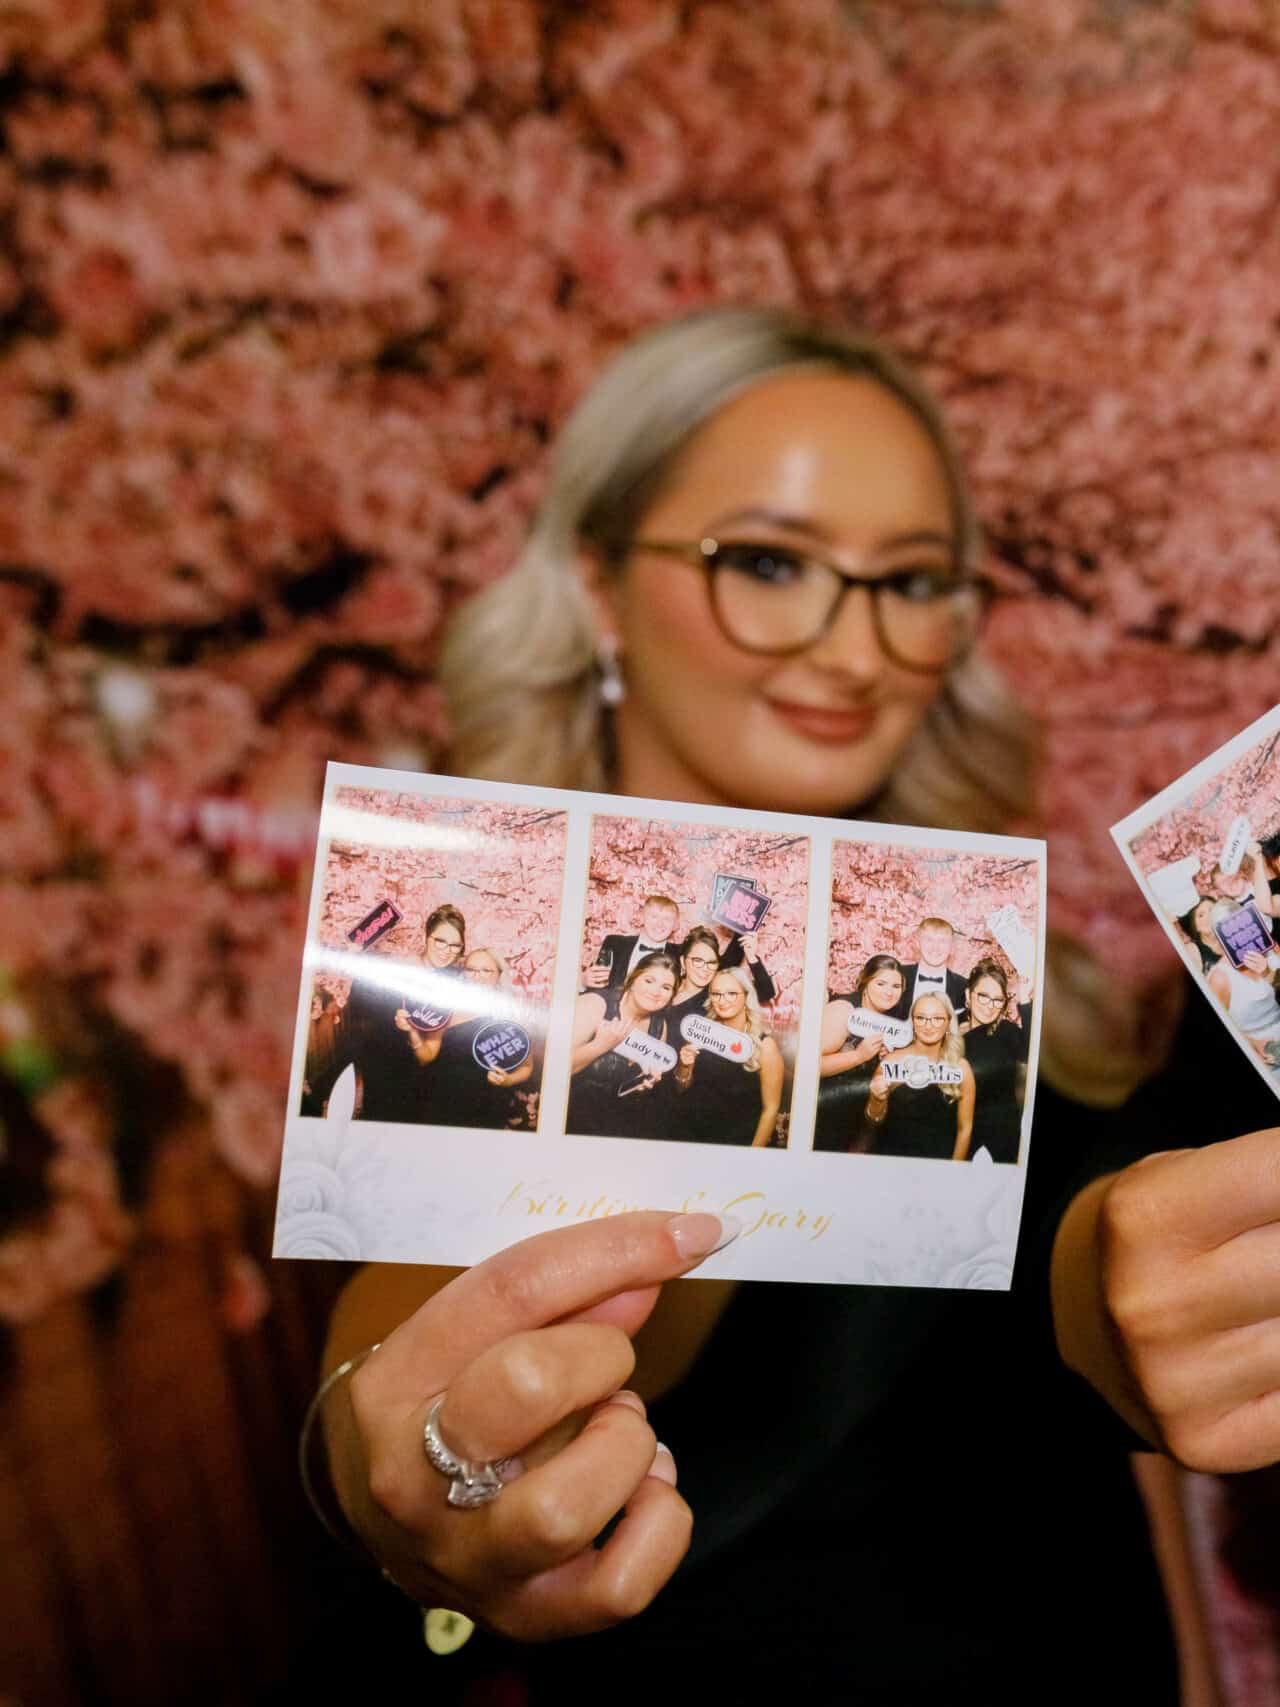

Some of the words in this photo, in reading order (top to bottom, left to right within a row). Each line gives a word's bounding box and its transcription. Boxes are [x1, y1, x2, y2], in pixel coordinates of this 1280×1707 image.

[690, 1018, 713, 1033] Just
[476, 1026, 517, 1054] WHAT
[484, 1038, 526, 1067] EVER
[624, 1036, 651, 1057] Lady
[686, 1027, 727, 1053] Swiping
[884, 1062, 909, 1081] Mr
[928, 1063, 962, 1082] Mrs
[498, 1178, 644, 1218] Kirsti
